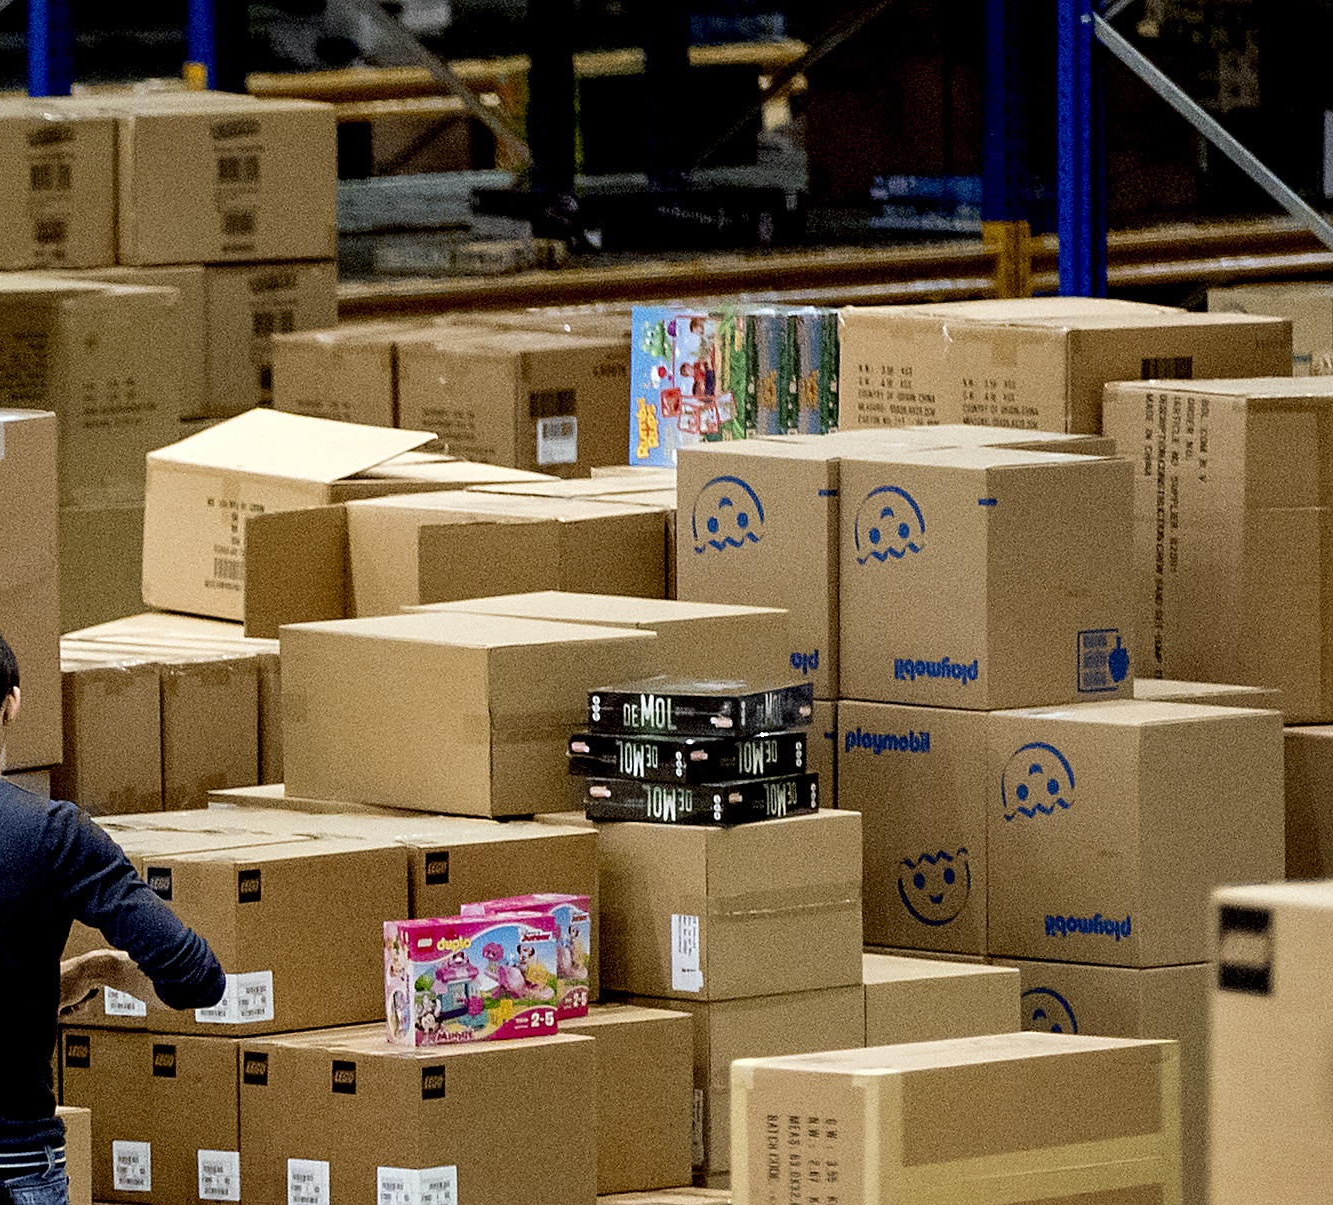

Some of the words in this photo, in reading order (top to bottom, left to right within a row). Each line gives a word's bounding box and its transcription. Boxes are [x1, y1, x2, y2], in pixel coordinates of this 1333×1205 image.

[894, 656, 979, 685] playmobil
[639, 693, 678, 731] MOL
[845, 727, 931, 755] playmobil
[616, 740, 645, 778] MOL
[735, 740, 764, 775] MOL
[642, 783, 677, 821] MOL
[240, 879, 259, 894] LEGO
[1043, 913, 1132, 942] playmobil
[437, 936, 472, 953] duplo
[530, 1011, 554, 1027] 2-5
[67, 1045, 90, 1059] LEGO
[154, 1052, 175, 1067] LEGO
[244, 1061, 266, 1076] LEGO
[334, 1069, 356, 1084] LEGO
[423, 1075, 445, 1091] LEGO
